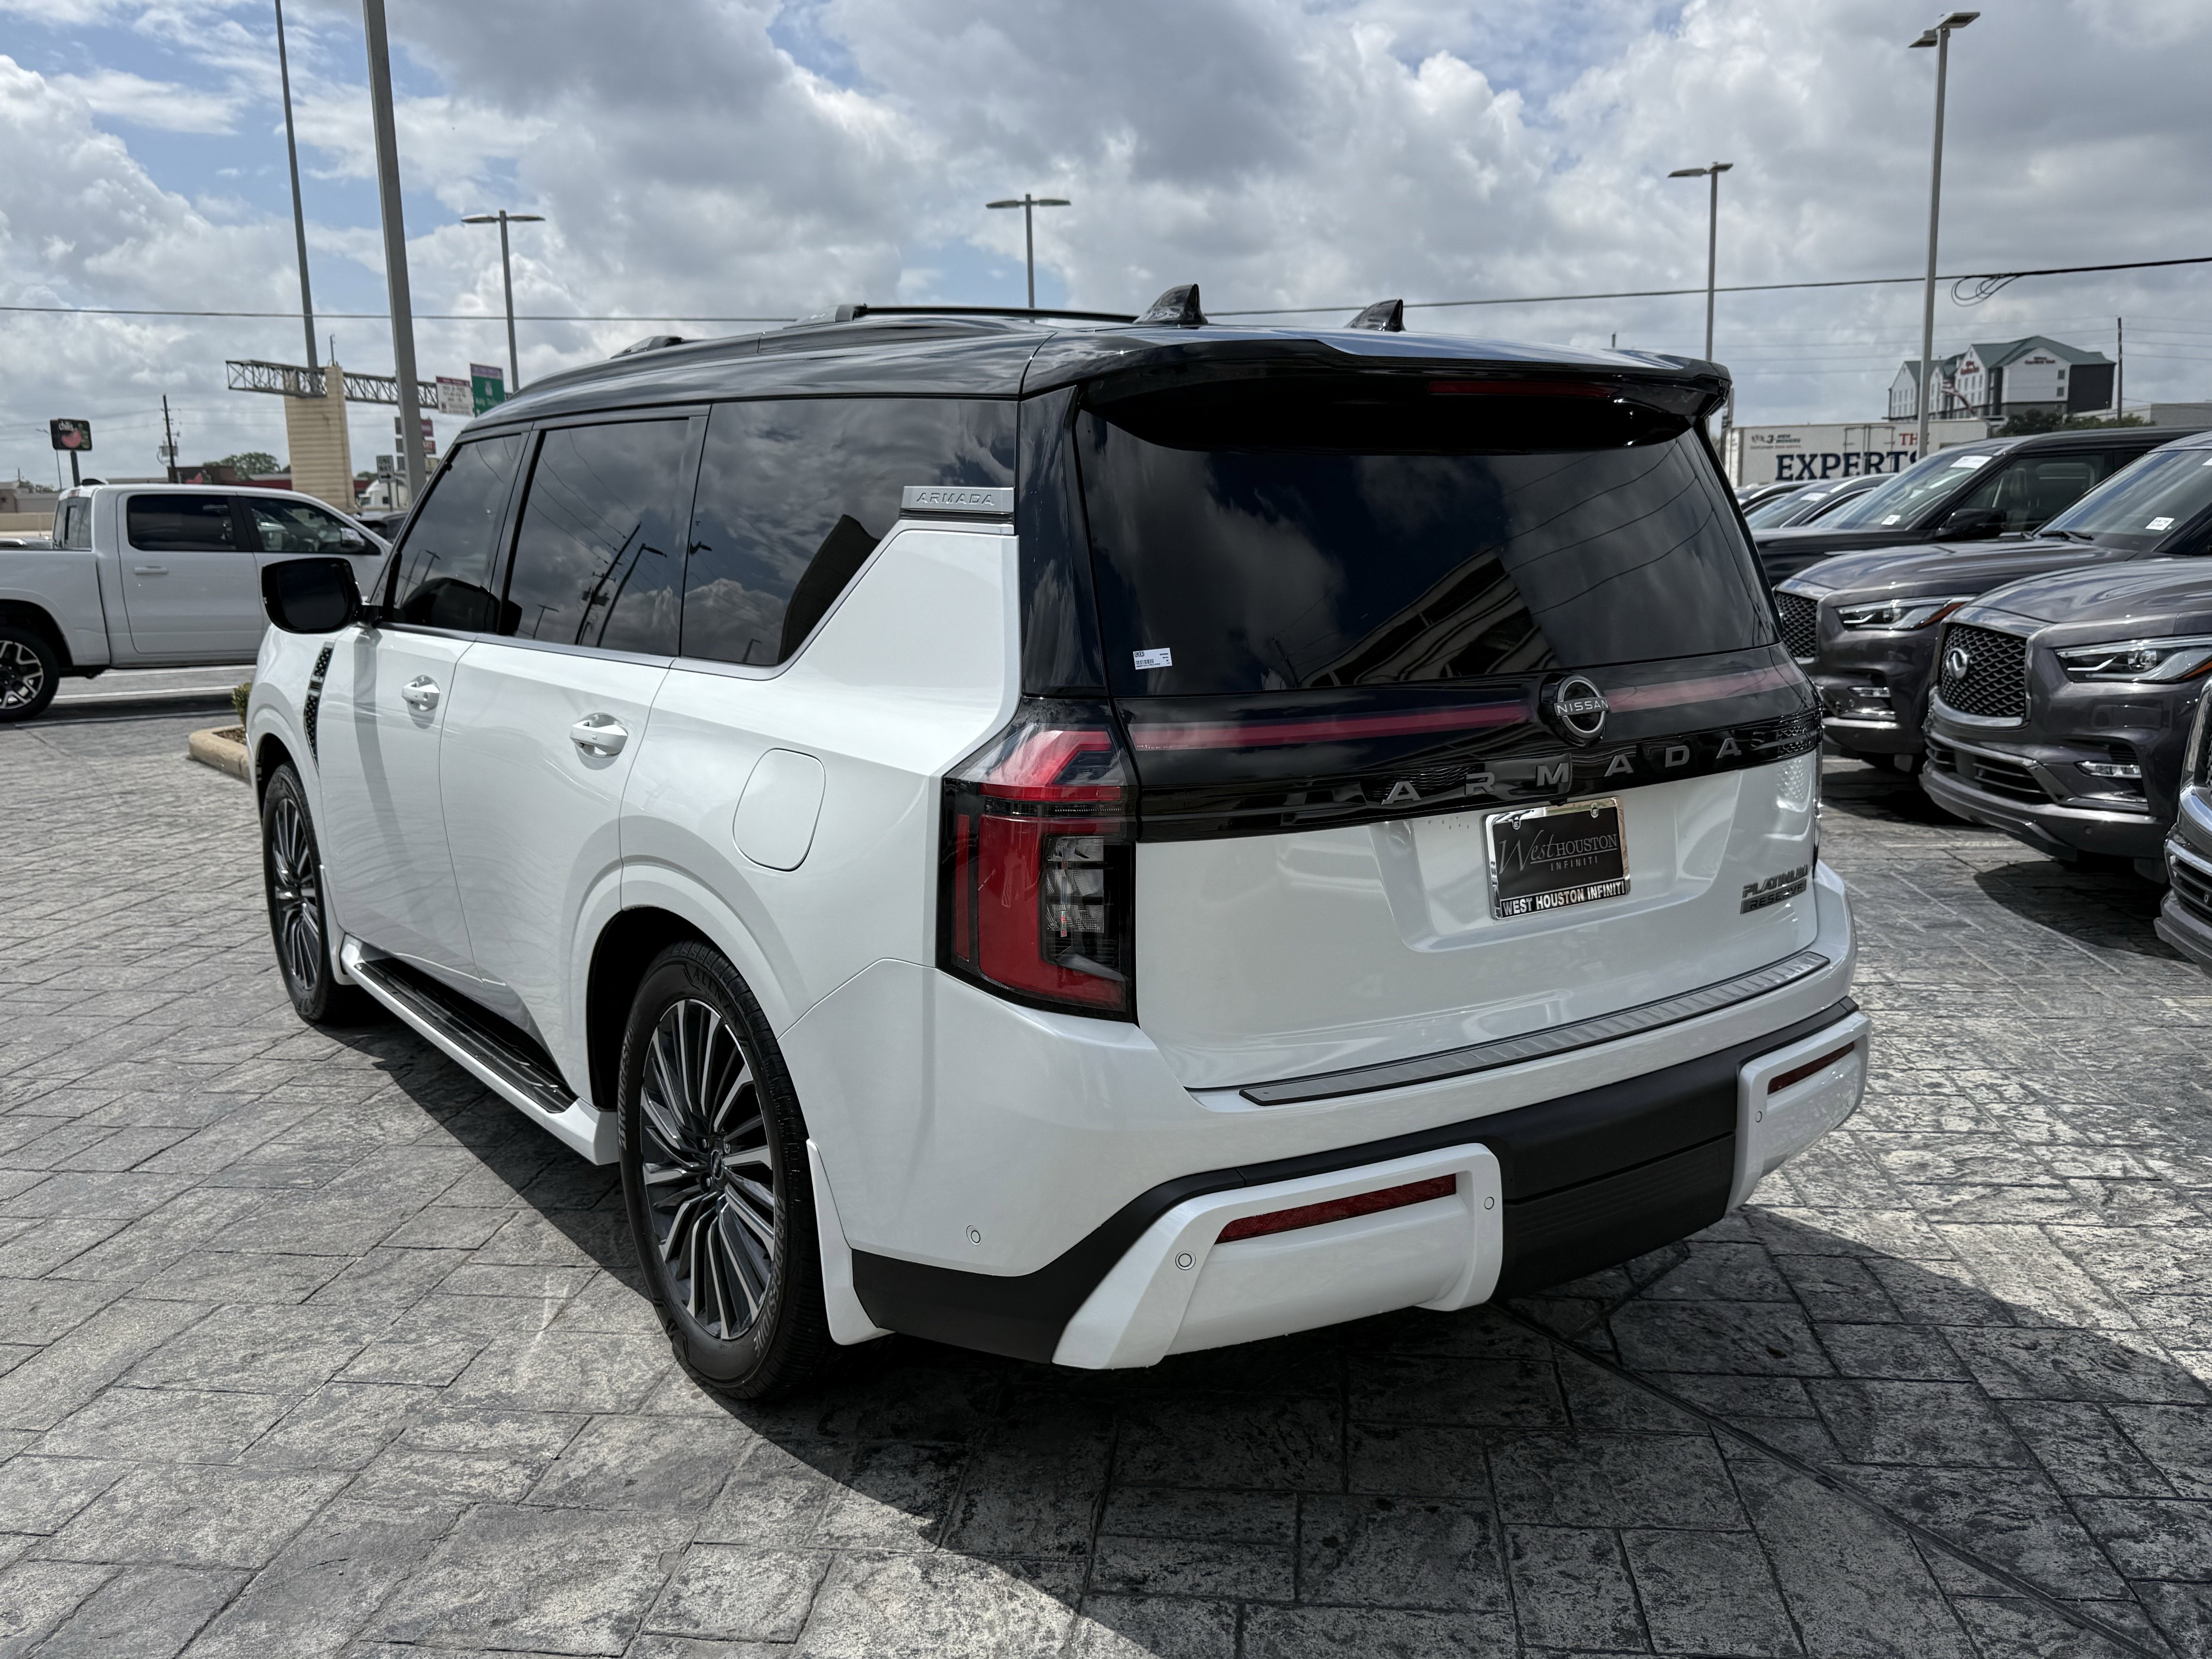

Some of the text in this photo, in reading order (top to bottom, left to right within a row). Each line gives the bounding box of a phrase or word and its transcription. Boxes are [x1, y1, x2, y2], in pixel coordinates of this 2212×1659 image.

[1899, 432, 1929, 446] TH
[917, 493, 994, 506] ARMADA
[1556, 700, 1609, 714] NISSAN
[1381, 737, 1741, 805] ARMADA
[1551, 855, 1598, 871] INFINITI
[1743, 864, 1808, 898] PLATINUM
[1503, 880, 1625, 915] WEST HOUSTON INFINITI
[1750, 883, 1803, 909] RESERVE
